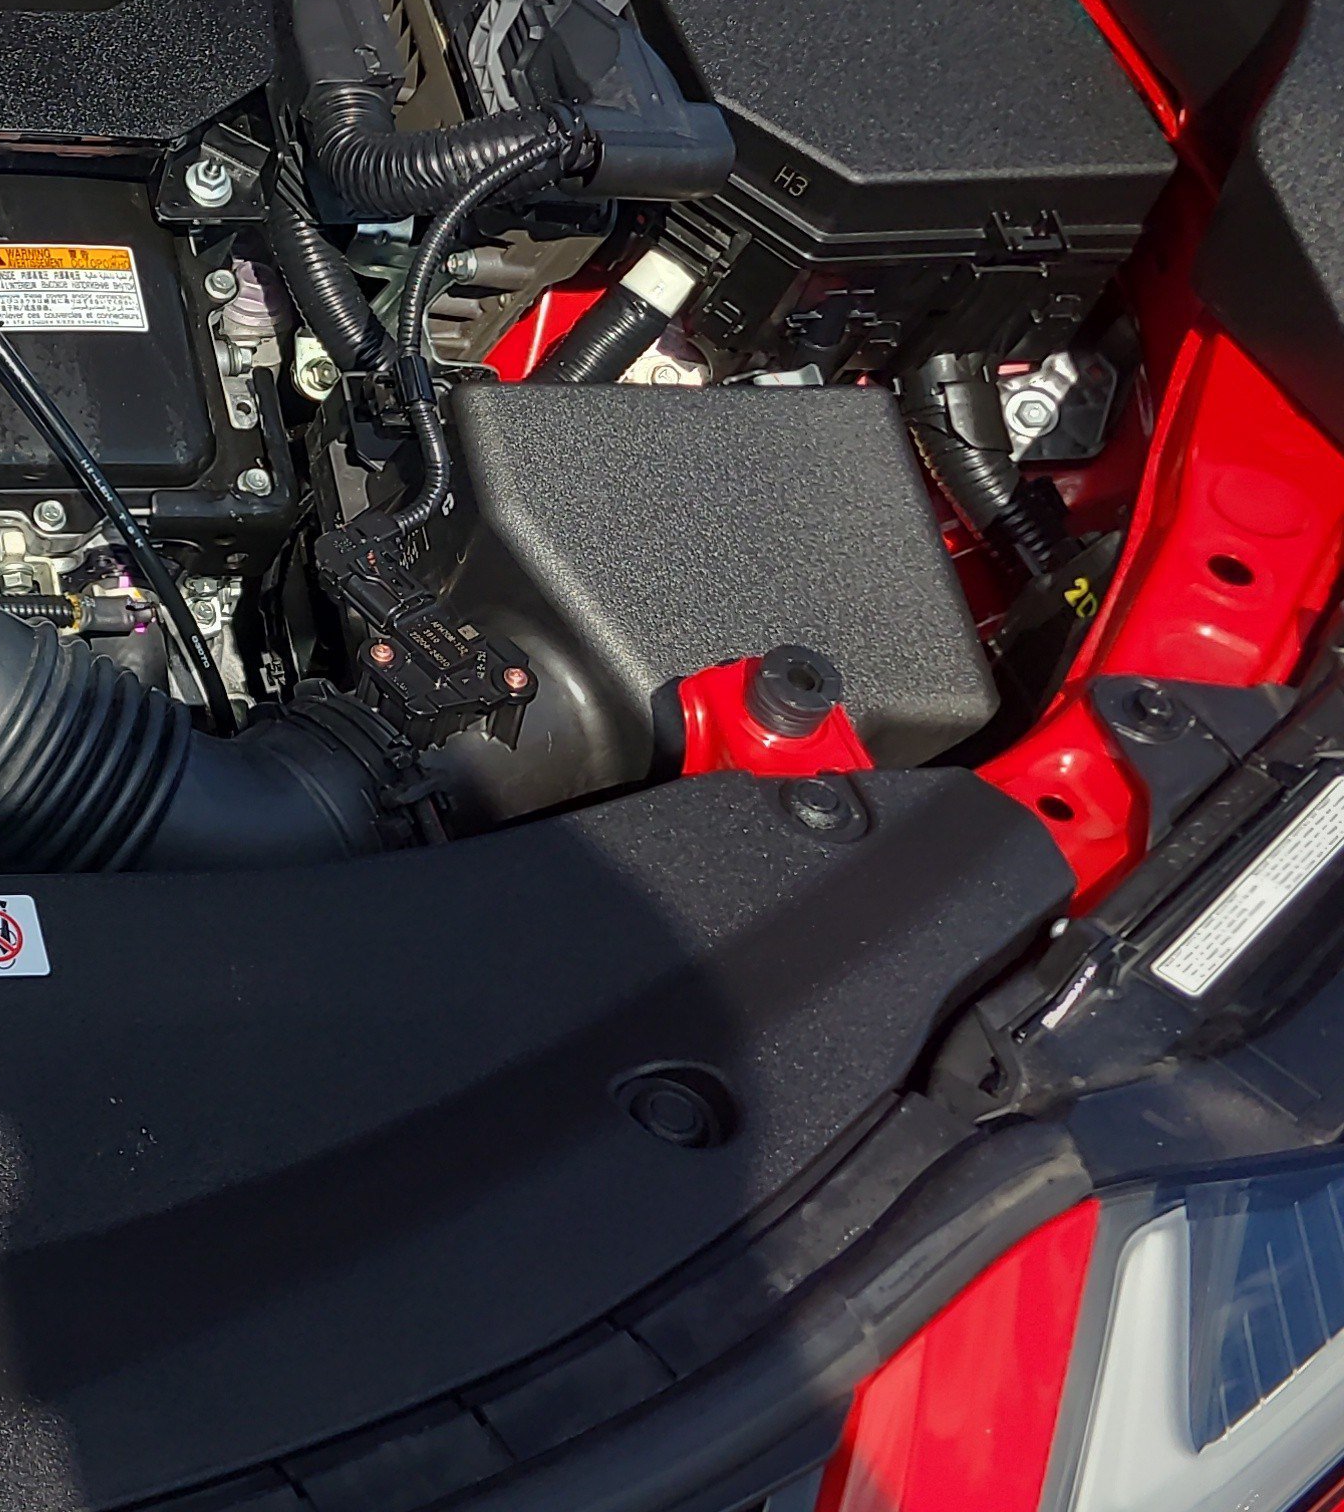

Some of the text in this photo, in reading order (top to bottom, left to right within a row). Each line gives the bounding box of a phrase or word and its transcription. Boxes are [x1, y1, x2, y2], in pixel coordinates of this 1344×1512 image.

[774, 166, 809, 197] H3
[6, 248, 51, 259] WARNING
[80, 459, 114, 502] HI-LEX
[191, 635, 211, 669] 03070
